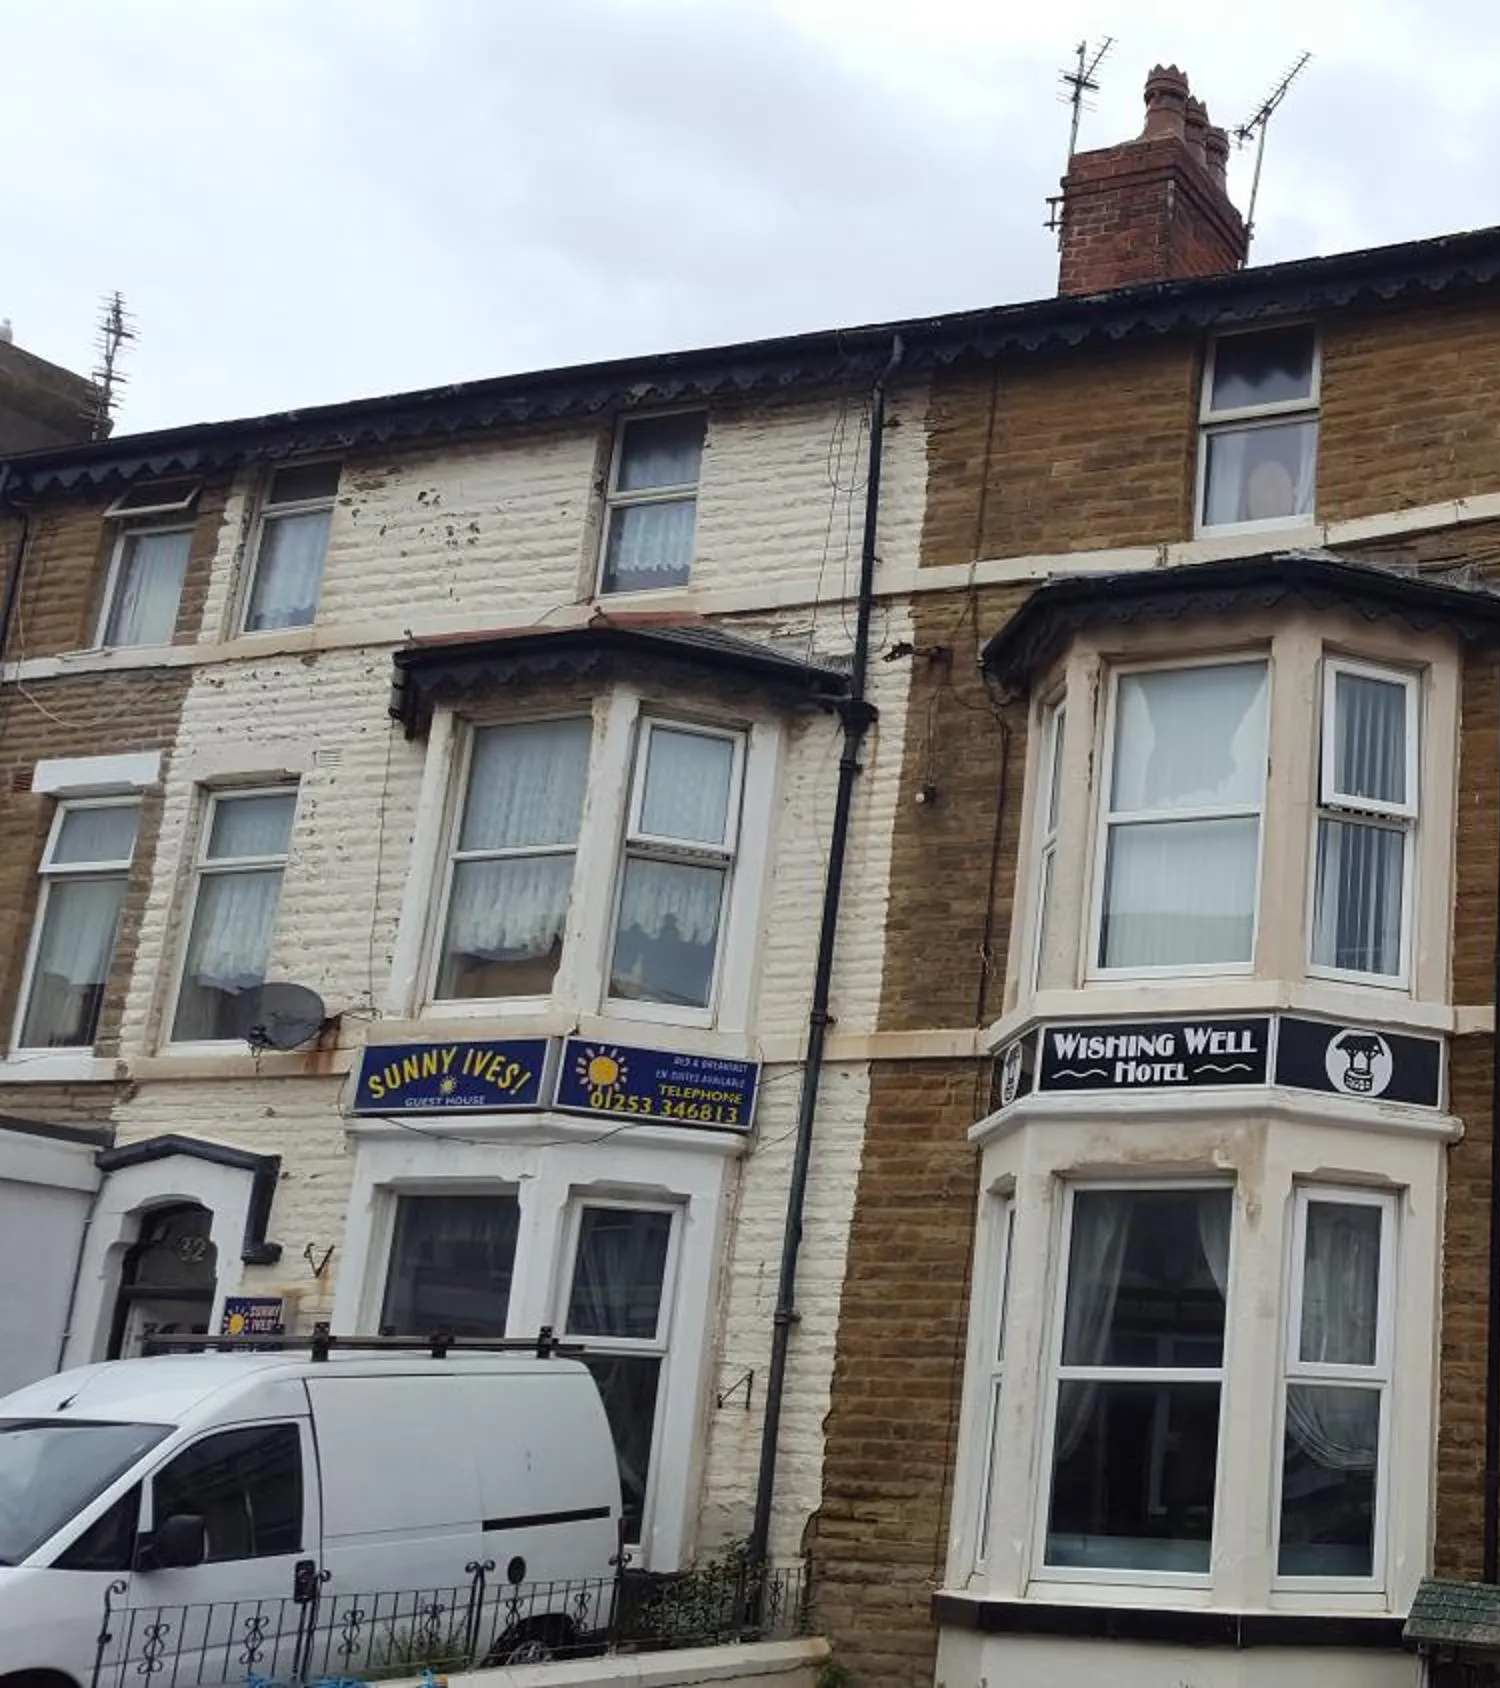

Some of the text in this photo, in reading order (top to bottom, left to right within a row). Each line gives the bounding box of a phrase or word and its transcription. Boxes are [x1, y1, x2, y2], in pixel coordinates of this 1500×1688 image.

[1184, 1026, 1259, 1056] WELL
[368, 1046, 532, 1099] SUNNY IVES!
[1114, 1060, 1189, 1083] HOTEL
[404, 1095, 486, 1107] GUEST HOUSE
[590, 1089, 738, 1124] 01253 346813
[659, 1084, 744, 1104] TELEPHONE
